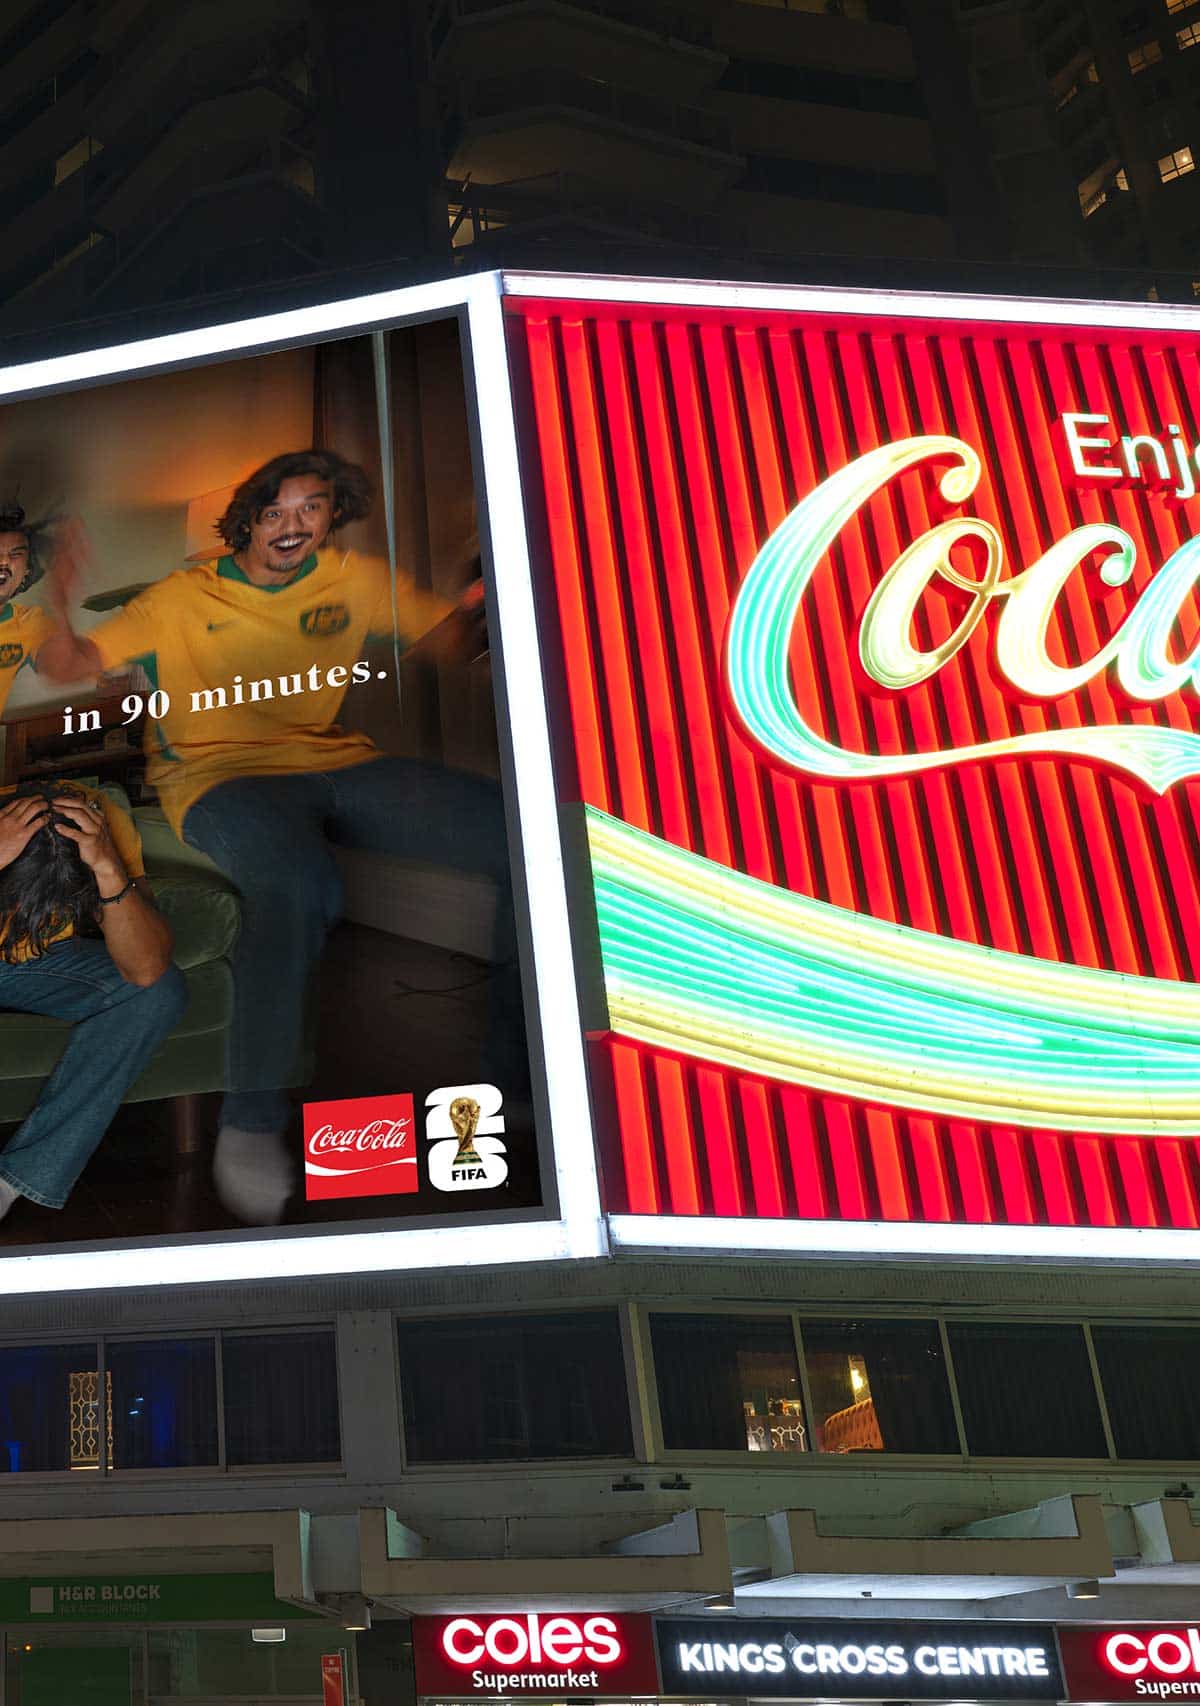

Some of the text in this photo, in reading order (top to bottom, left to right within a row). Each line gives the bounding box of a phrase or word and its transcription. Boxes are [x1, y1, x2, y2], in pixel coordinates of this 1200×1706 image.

[1062, 413, 1200, 499] Enj
[62, 659, 388, 736] in 90 minutes.
[308, 1117, 412, 1155] Coca-Cola
[451, 1168, 487, 1181] FIFA
[60, 1585, 161, 1601] H&R BLOCK
[442, 1614, 621, 1665] coles
[1106, 1628, 1200, 1674] col
[679, 1643, 1049, 1677] KINGS CROSS CENTRE
[472, 1668, 599, 1693] Supermarket
